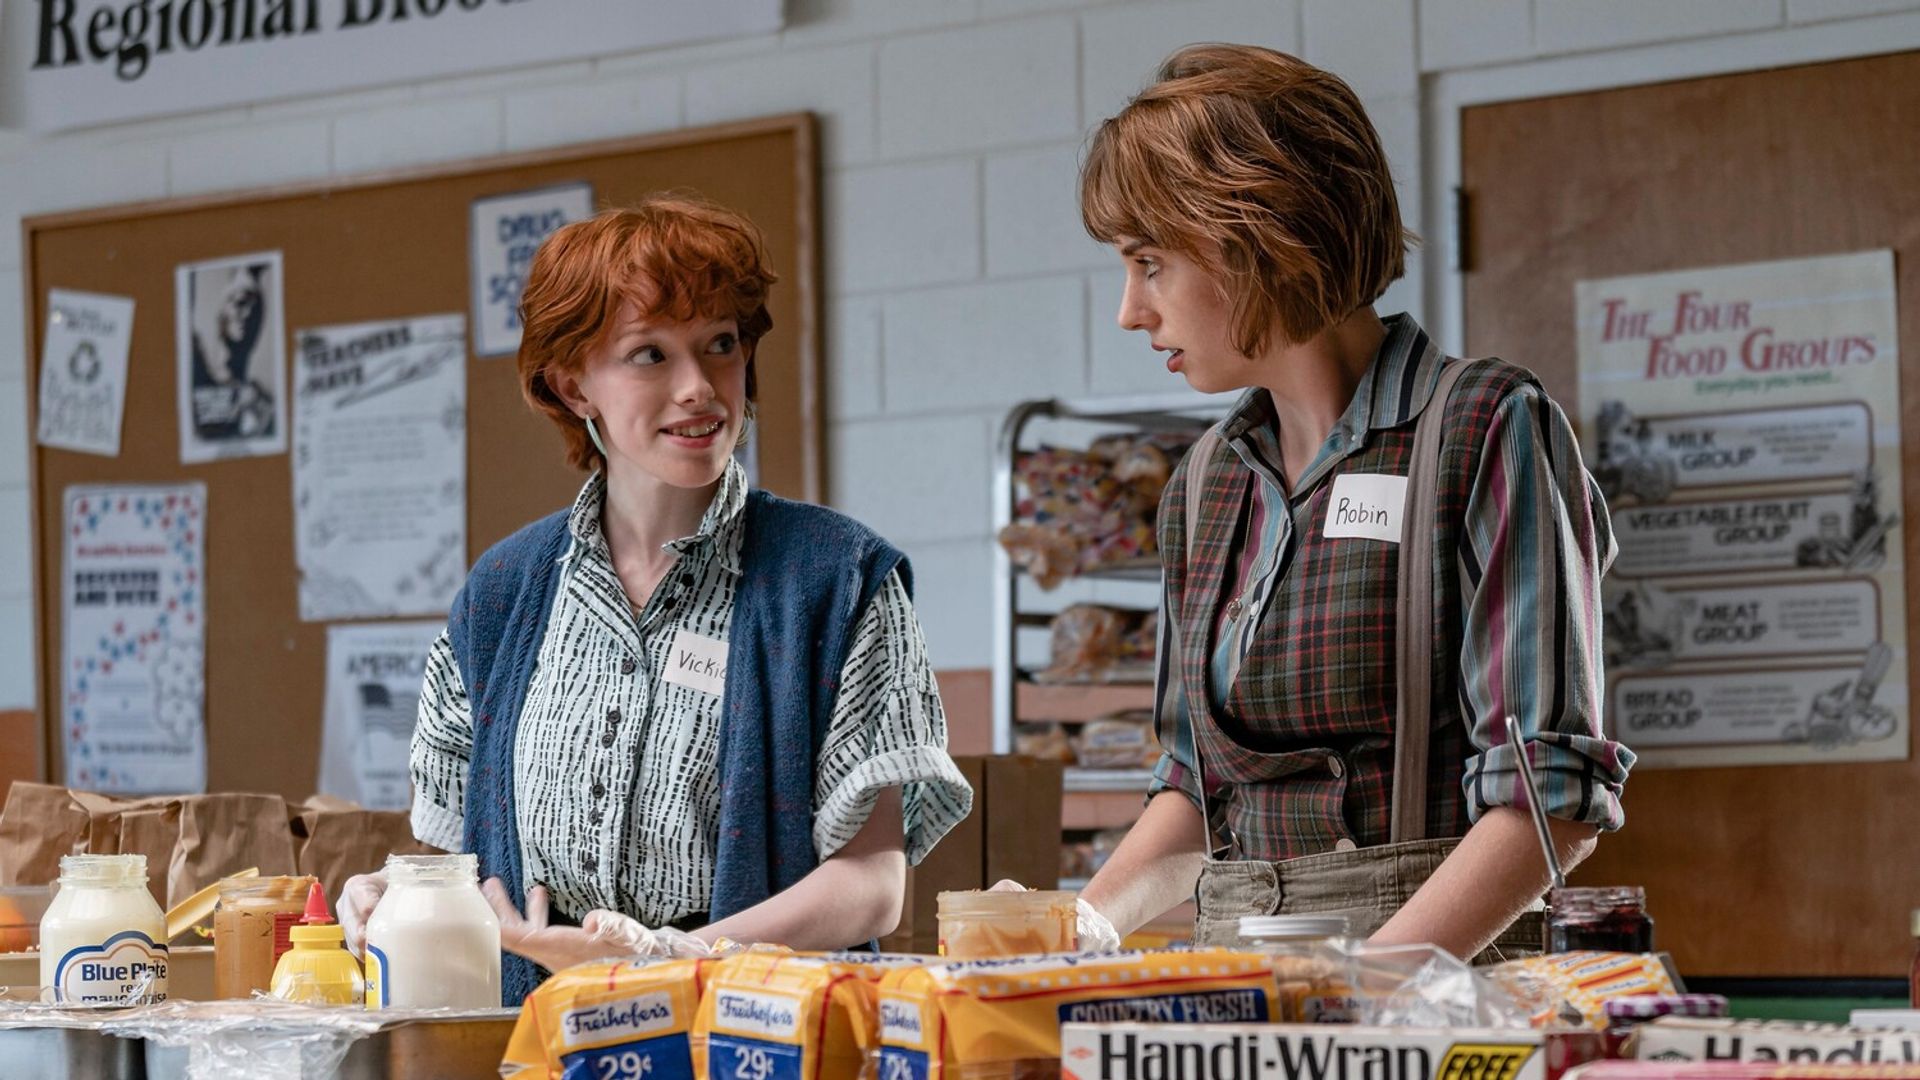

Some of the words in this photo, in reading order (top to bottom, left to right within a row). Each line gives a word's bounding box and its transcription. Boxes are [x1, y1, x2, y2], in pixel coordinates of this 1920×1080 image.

[1601, 299, 1653, 342] THE
[1672, 291, 1752, 335] FOUR
[305, 327, 412, 366] TEACHERS
[1644, 335, 1728, 379] FOOD
[1740, 328, 1876, 374] GROUPS
[307, 363, 364, 393] HAVE
[1668, 431, 1715, 447] MILK
[1681, 447, 1756, 471] GROUP
[1336, 497, 1388, 526] Robin
[1629, 502, 1810, 531] VEGETABLE-FRUIT
[1714, 525, 1791, 545] GROUP
[1702, 603, 1761, 621] MEAT
[1694, 623, 1768, 644] GROUP
[1625, 690, 1693, 710] BREAD
[1628, 710, 1702, 731] GROUP
[82, 963, 128, 981] Blue
[566, 1002, 670, 1034] Freihofer's
[719, 995, 793, 1027] Freihofer's
[1070, 998, 1175, 1023] COUNTRY
[1182, 990, 1257, 1021] FRESH
[1100, 1033, 1432, 1080] Handi-Wrap
[1441, 1054, 1518, 1080] FREE
